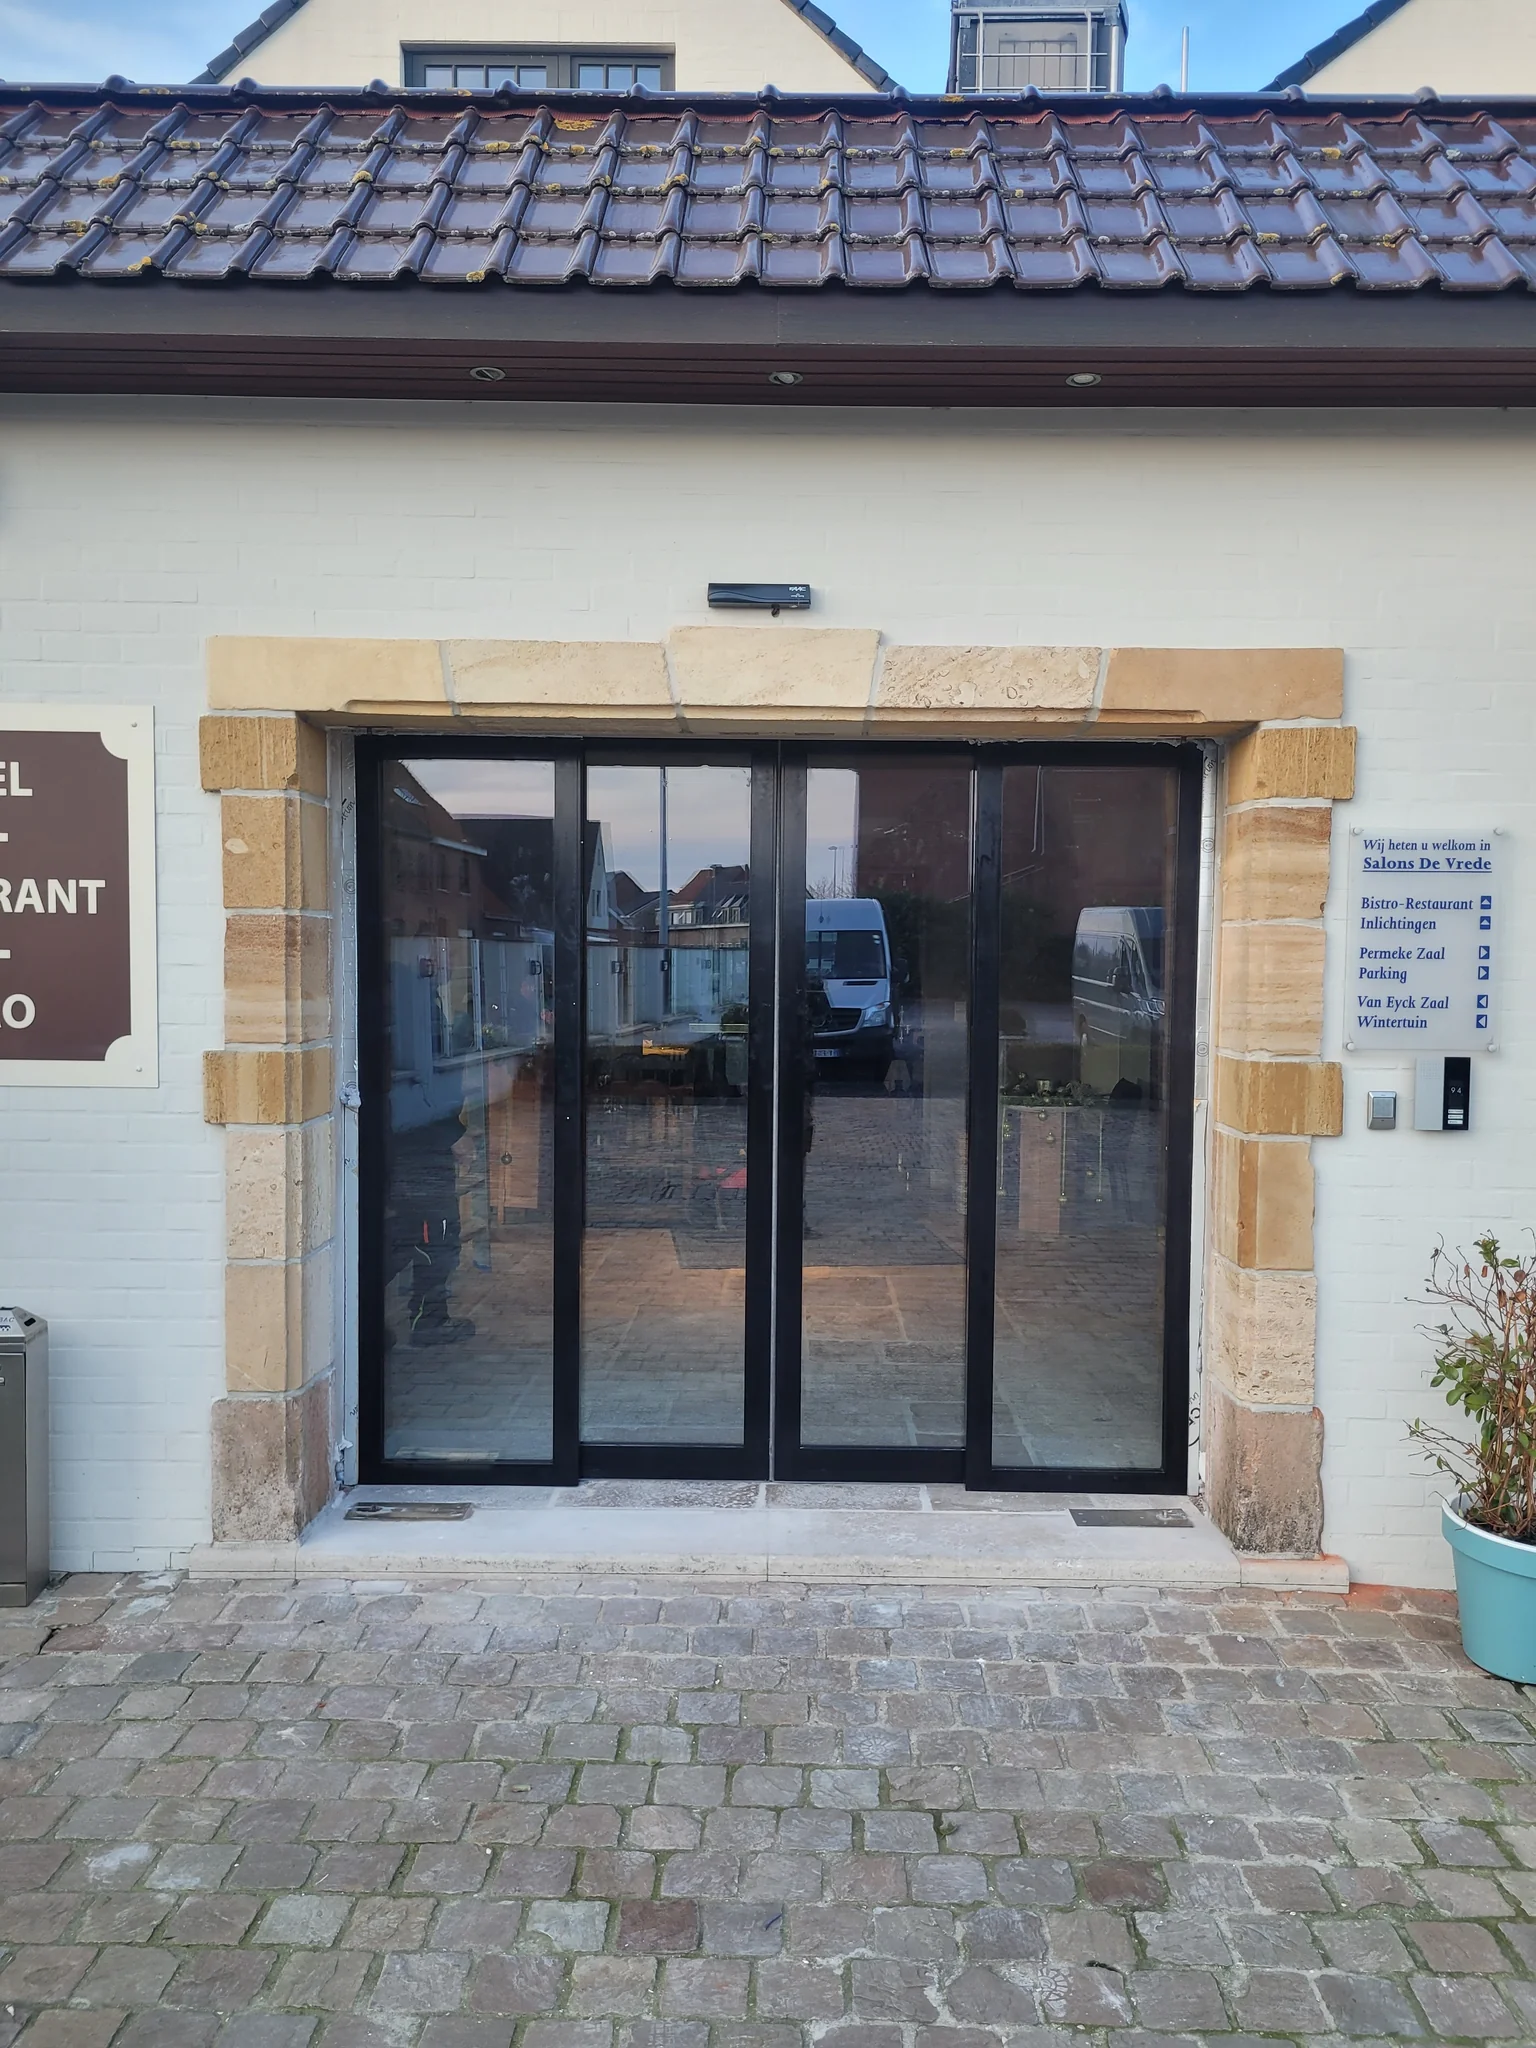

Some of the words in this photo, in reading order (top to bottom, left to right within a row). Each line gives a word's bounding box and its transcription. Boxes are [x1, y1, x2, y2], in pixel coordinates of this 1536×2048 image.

[1363, 838, 1385, 854] Wij
[1388, 838, 1418, 851] heten
[1421, 841, 1428, 851] u
[1432, 839, 1476, 851] welkom
[1480, 839, 1491, 851] in
[1363, 856, 1415, 870] Salons
[1418, 857, 1440, 870] De
[1445, 857, 1492, 870] Vrede
[1361, 896, 1474, 910] Bistro-Restaurant
[1360, 916, 1437, 934] Inlichtingen
[1359, 946, 1412, 960] Permeke
[1416, 946, 1445, 960] Zaal
[1358, 966, 1407, 984] Parking
[0, 993, 36, 1029] O
[1357, 995, 1382, 1008] Van
[1386, 995, 1416, 1012] Eyck
[1420, 996, 1449, 1009] Zaal
[1357, 1015, 1428, 1029] Wintertuin
